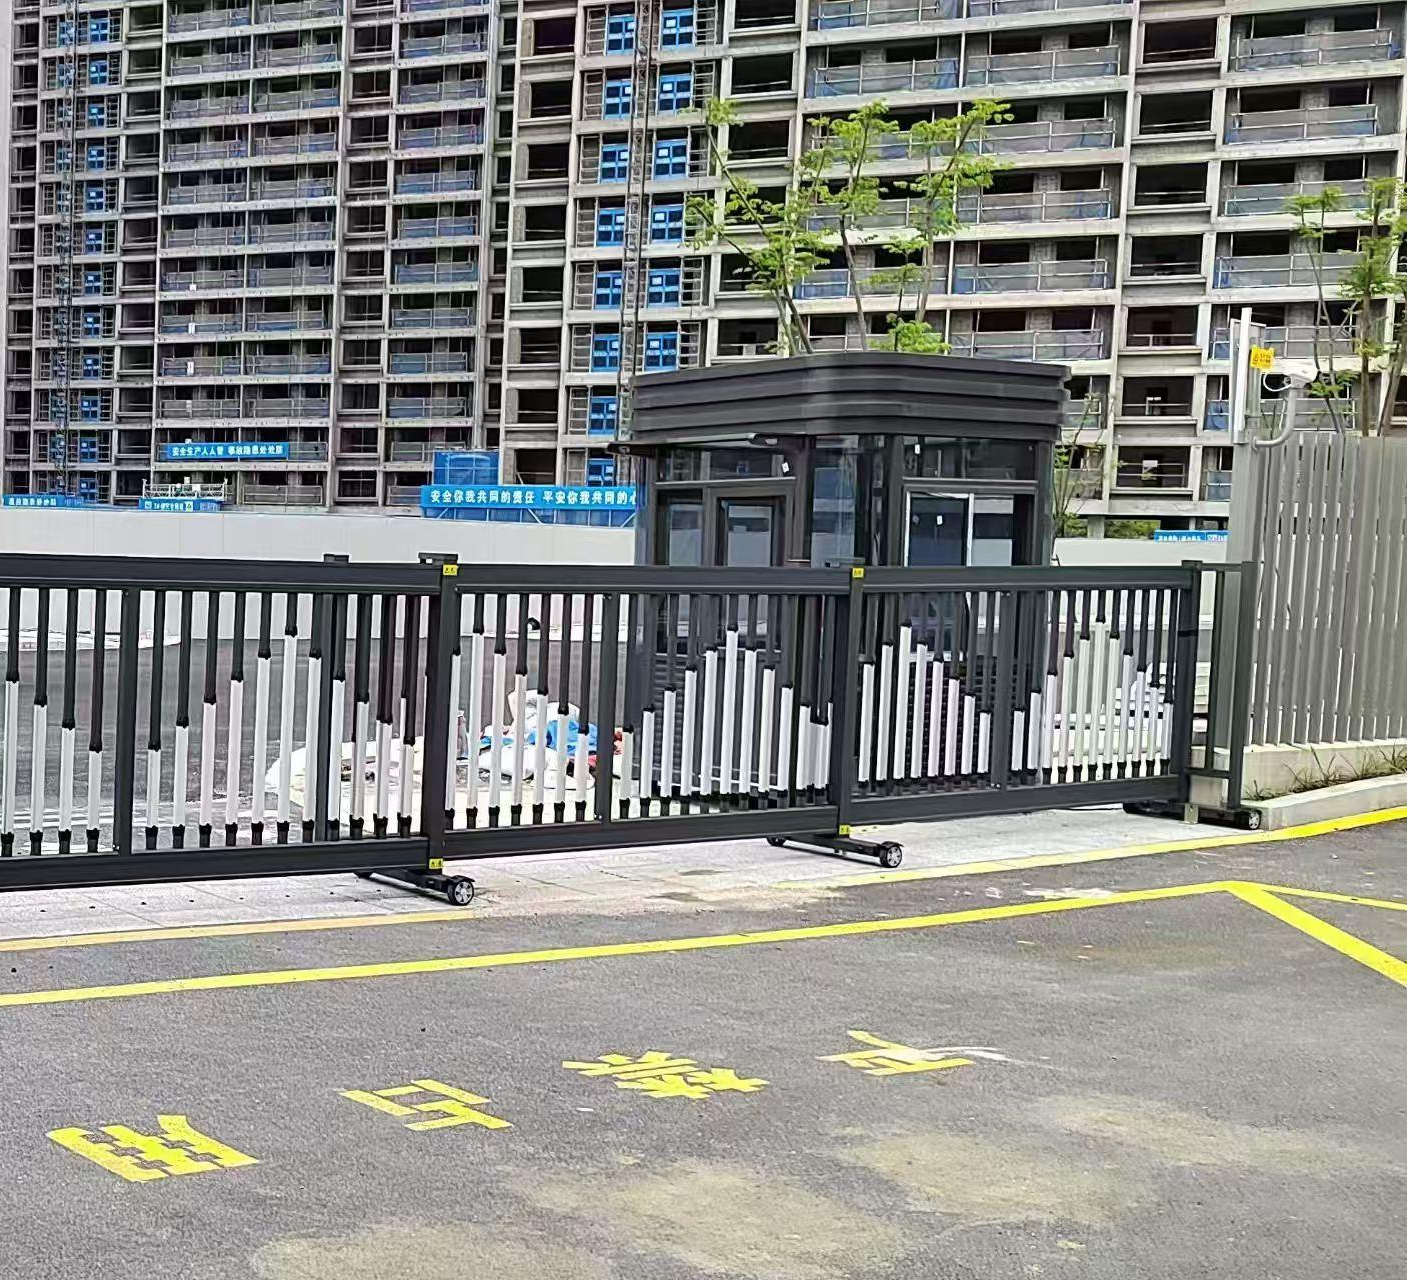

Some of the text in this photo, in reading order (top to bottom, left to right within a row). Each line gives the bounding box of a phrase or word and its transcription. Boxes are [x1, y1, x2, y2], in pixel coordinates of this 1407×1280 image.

[430, 489, 535, 504] 安全你我共同的责任
